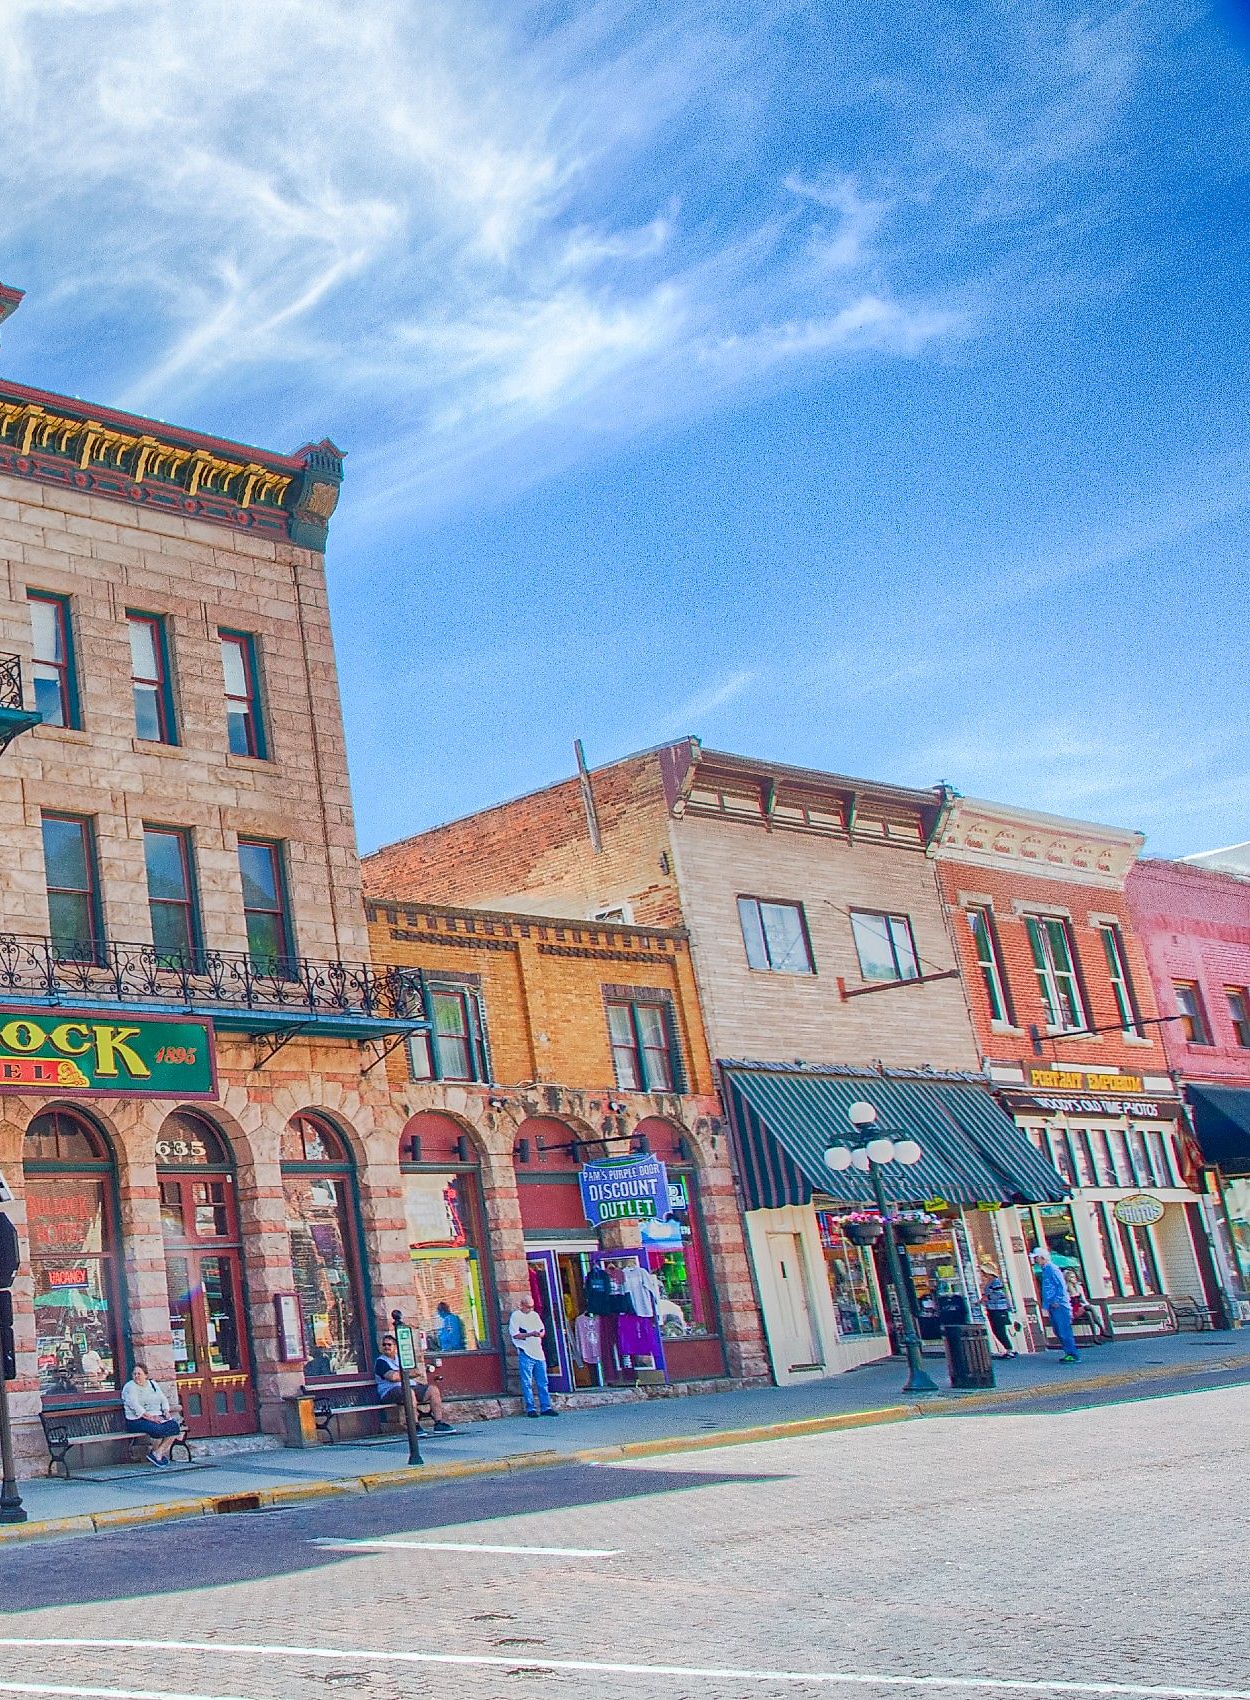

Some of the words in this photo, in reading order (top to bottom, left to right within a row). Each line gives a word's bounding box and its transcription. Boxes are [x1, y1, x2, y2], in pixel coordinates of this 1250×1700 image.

[154, 1046, 198, 1066] 1895
[1080, 1099, 1102, 1112] OLD
[1100, 1101, 1124, 1114] TIME
[1123, 1102, 1158, 1117] PHOTOS
[155, 1140, 207, 1156] 635
[582, 1169, 608, 1182] PAM'S
[609, 1168, 637, 1180] PURPLE
[639, 1163, 661, 1176] DOOR
[588, 1178, 659, 1202] DISCOUNT
[599, 1200, 654, 1220] OUTLET
[48, 1270, 86, 1284] VACANCY
